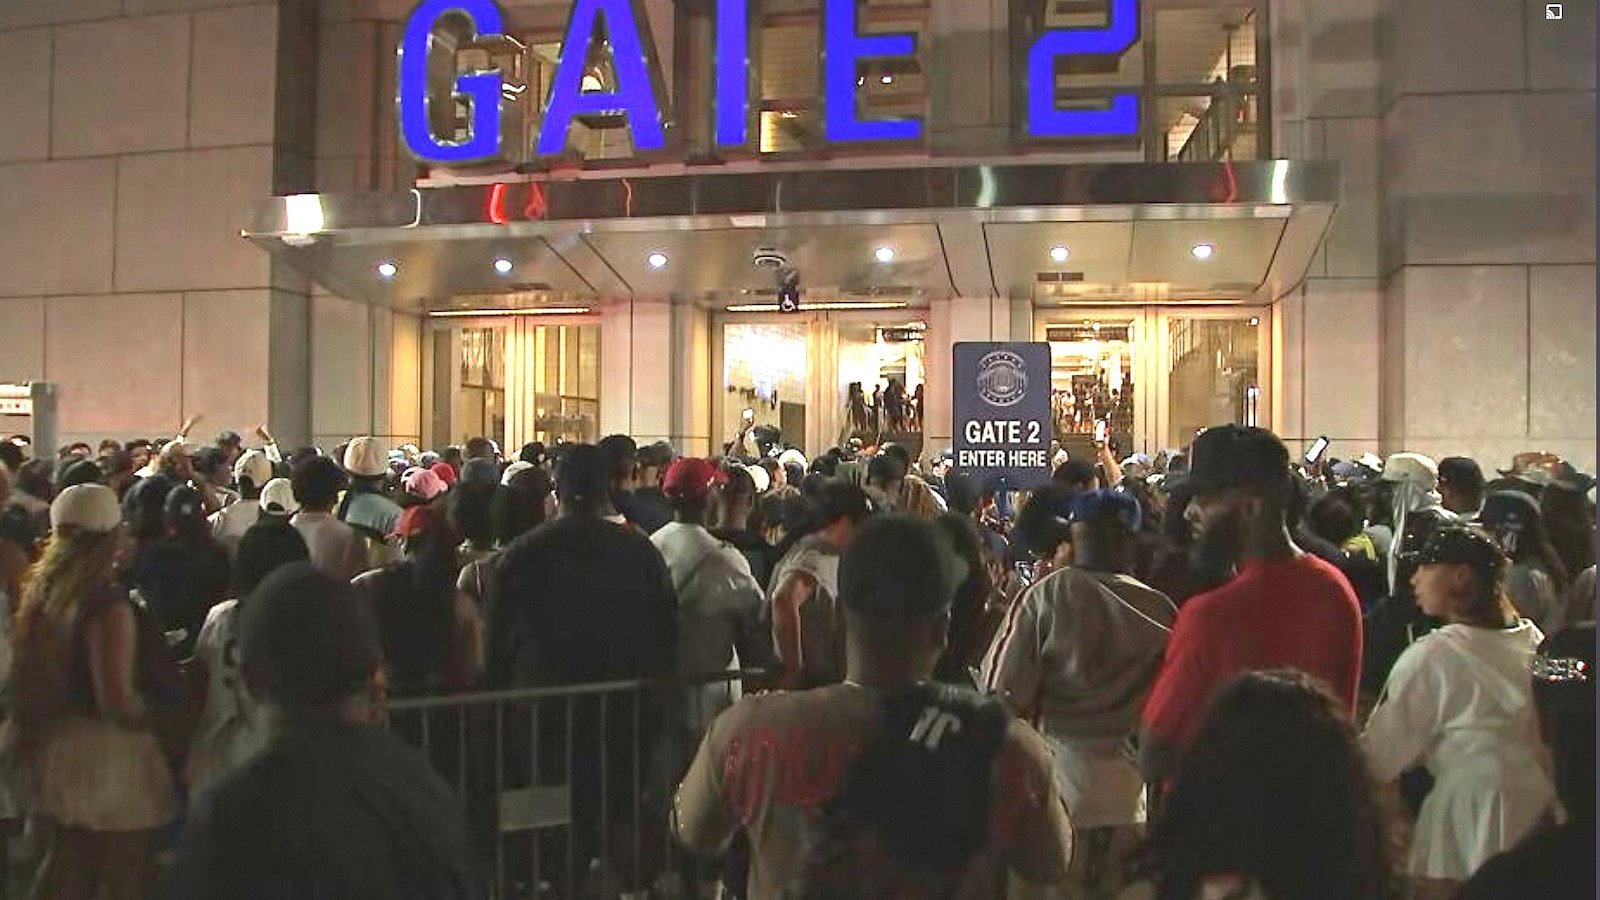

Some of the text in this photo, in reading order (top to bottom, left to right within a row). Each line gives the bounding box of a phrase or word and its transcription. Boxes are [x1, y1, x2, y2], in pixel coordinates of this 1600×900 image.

[1027, 0, 1138, 136] 2
[965, 420, 1040, 444] GATE 2
[959, 450, 1046, 467] ENTER HERE
